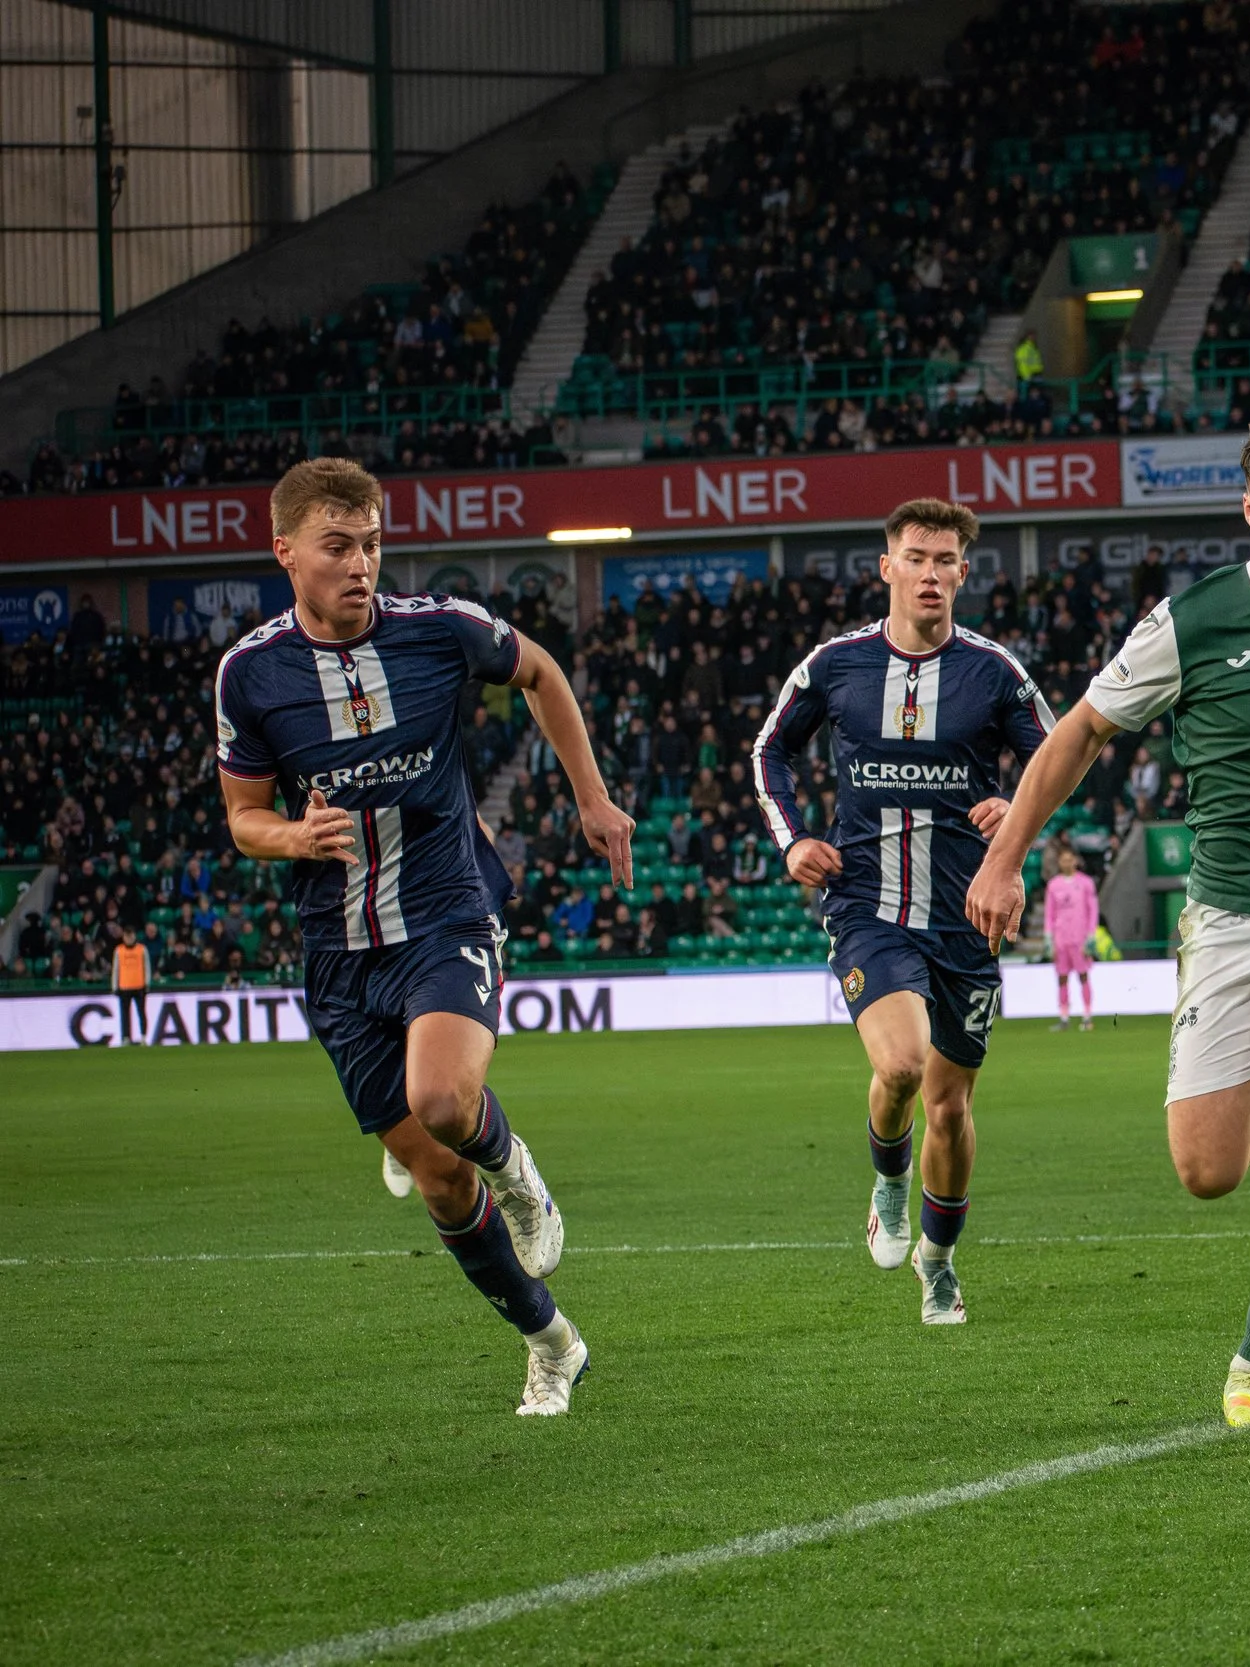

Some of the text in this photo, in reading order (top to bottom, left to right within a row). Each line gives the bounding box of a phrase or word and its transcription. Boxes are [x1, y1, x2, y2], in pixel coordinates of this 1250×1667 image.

[663, 466, 807, 524] LNER
[949, 450, 1097, 508] LNER
[110, 496, 249, 551] LNER
[383, 482, 525, 538] LNER
[310, 745, 434, 791] CROWN
[862, 762, 969, 781] CROWN
[863, 780, 969, 791] engineering services limited
